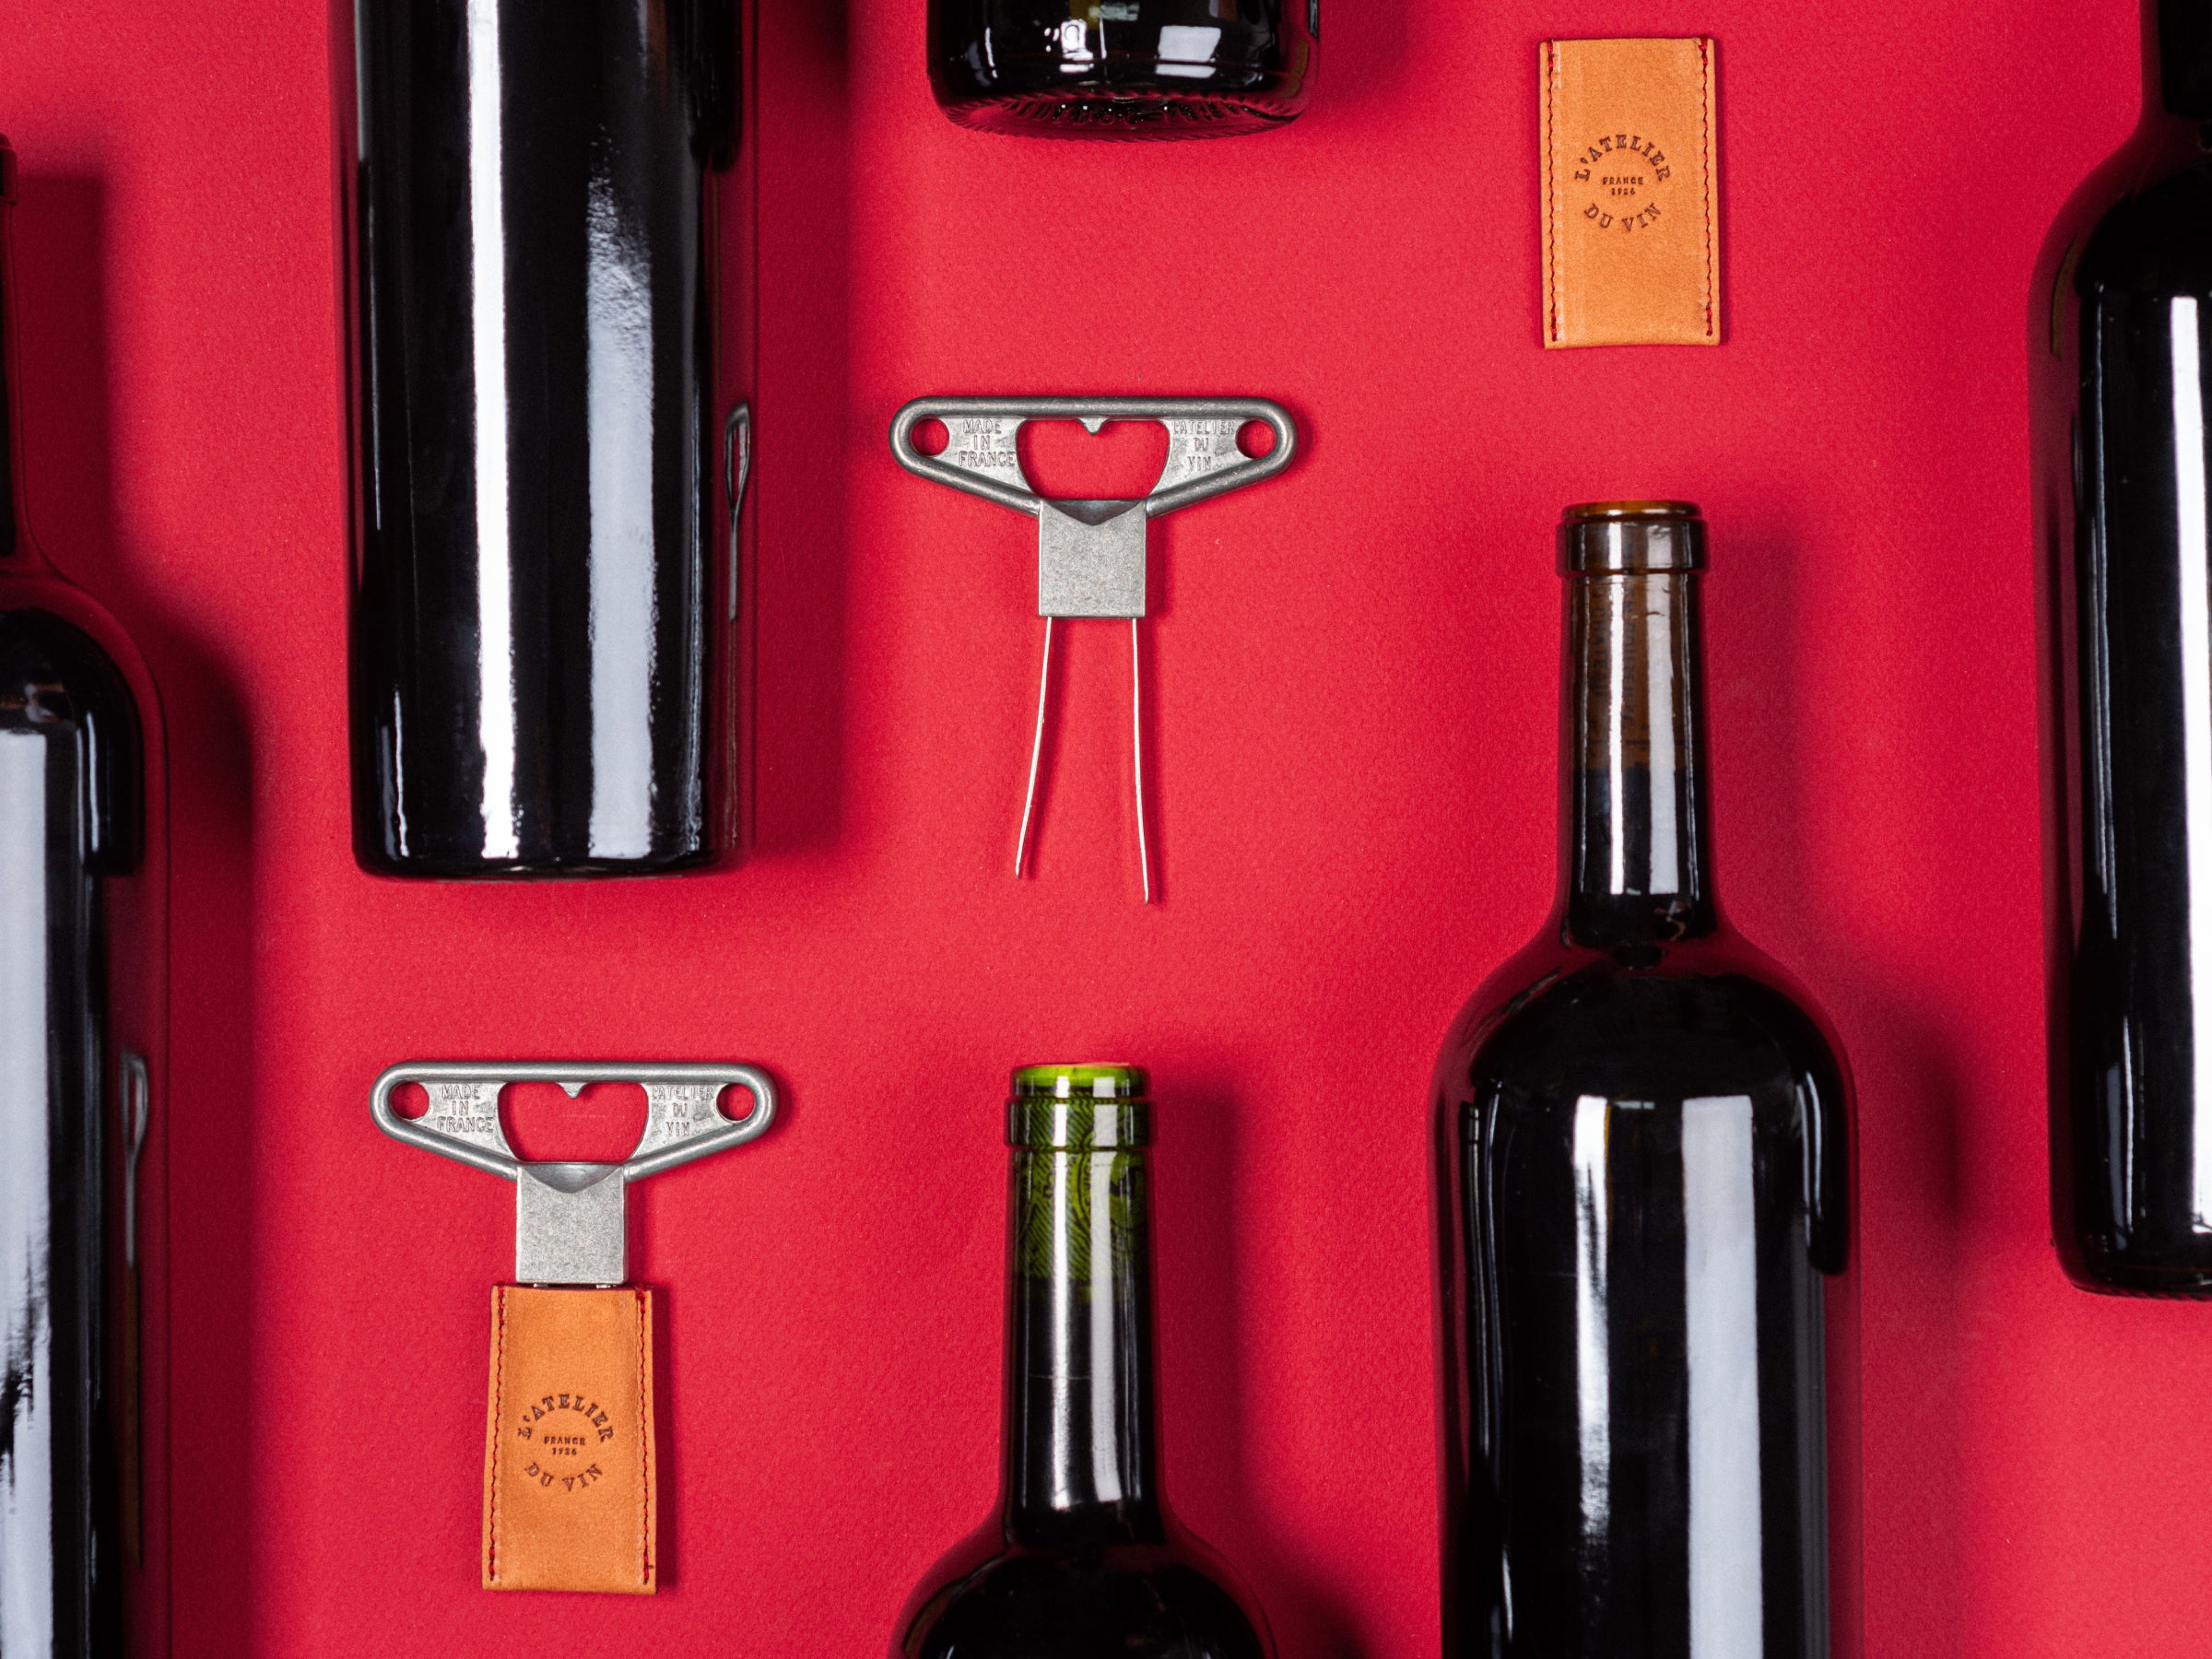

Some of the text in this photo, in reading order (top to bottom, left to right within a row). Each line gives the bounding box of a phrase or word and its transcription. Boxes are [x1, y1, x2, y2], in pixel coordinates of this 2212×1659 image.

[1574, 134, 1670, 182] L'ATELIER
[1602, 176, 1643, 185] FRANCE
[1611, 187, 1636, 195] 1926
[1583, 202, 1661, 232] DU VIN
[962, 418, 1003, 434] MADE
[973, 434, 991, 451] IN
[1193, 436, 1209, 452] DU
[959, 450, 1017, 467] FRANCE
[1186, 455, 1212, 472] VIN
[441, 1083, 481, 1100] MADE
[452, 1100, 469, 1116] IN
[672, 1102, 688, 1118] DU
[436, 1115, 495, 1133] FRANCE
[665, 1121, 690, 1137] VIN
[517, 1394, 614, 1443] L'ATELIER
[544, 1436, 586, 1445] FRANCE
[524, 1462, 603, 1492] DU VIN
